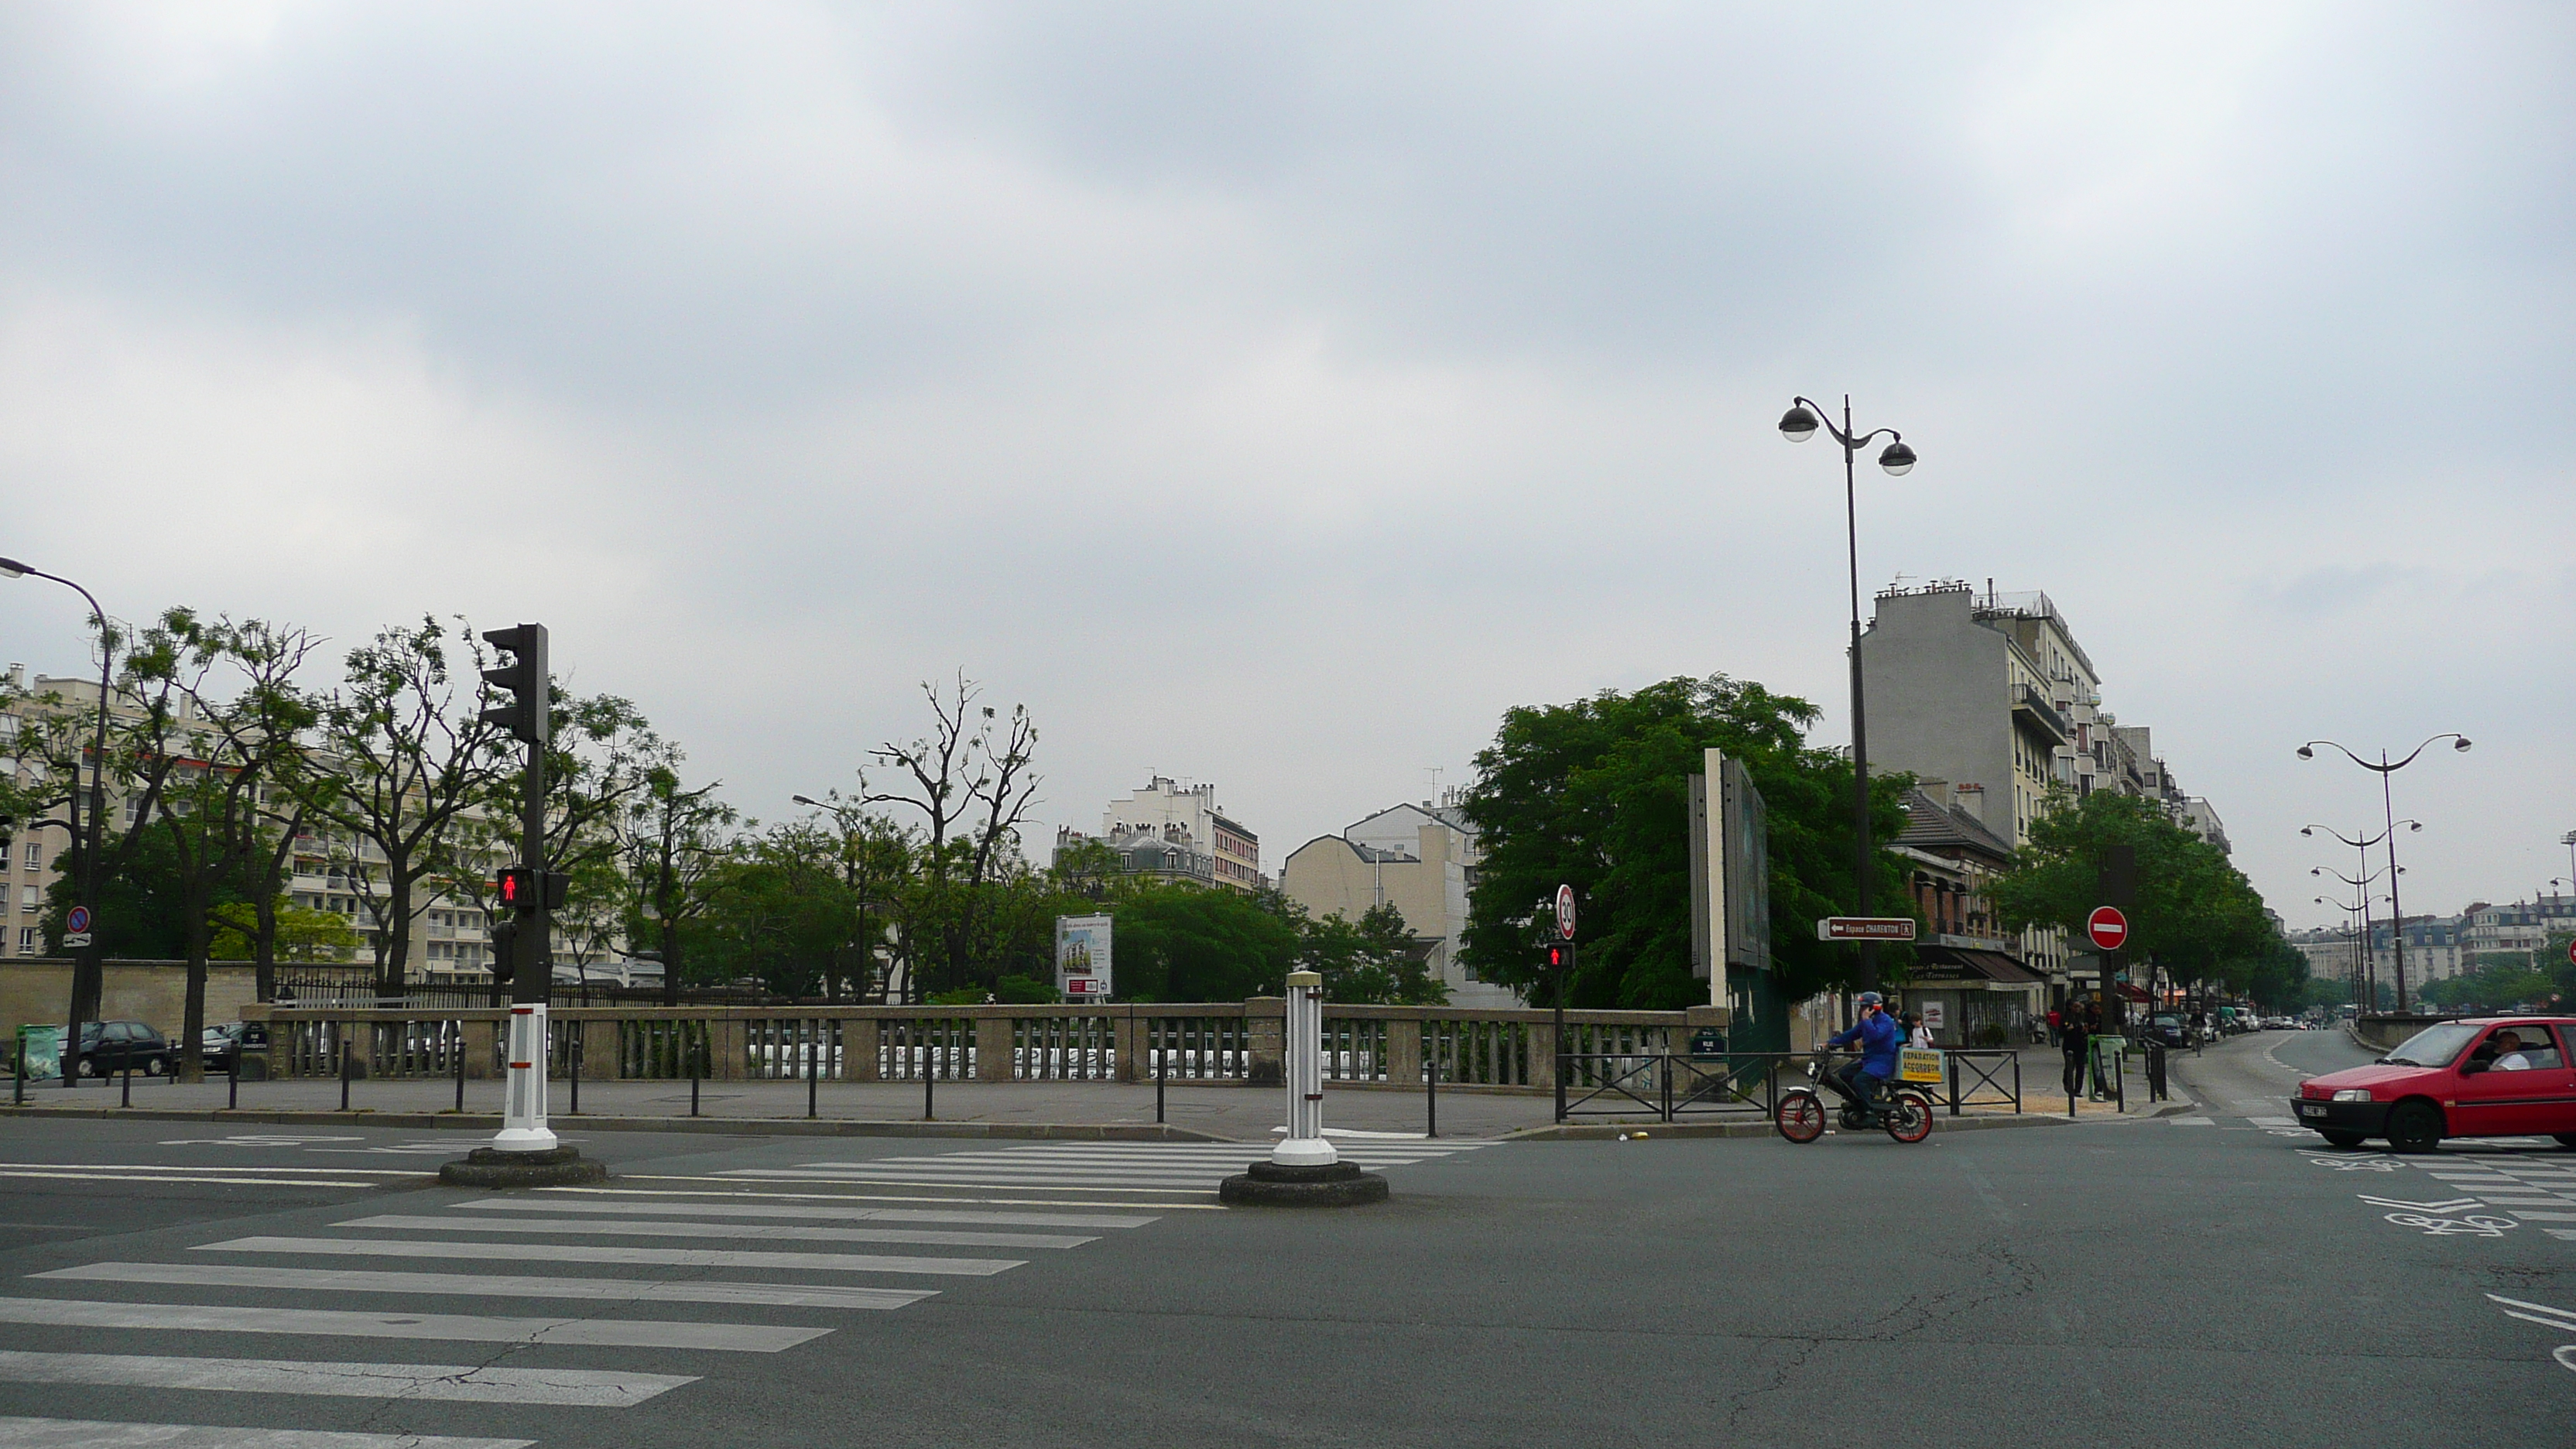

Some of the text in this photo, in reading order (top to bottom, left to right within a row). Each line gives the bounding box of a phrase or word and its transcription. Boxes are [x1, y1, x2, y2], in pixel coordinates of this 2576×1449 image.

[1562, 901, 1572, 923] 30
[1845, 924, 1899, 934] Espace CHARENTON
[1903, 1051, 1940, 1061] REPARATION
[1903, 1062, 1940, 1072] ACCORDEON
